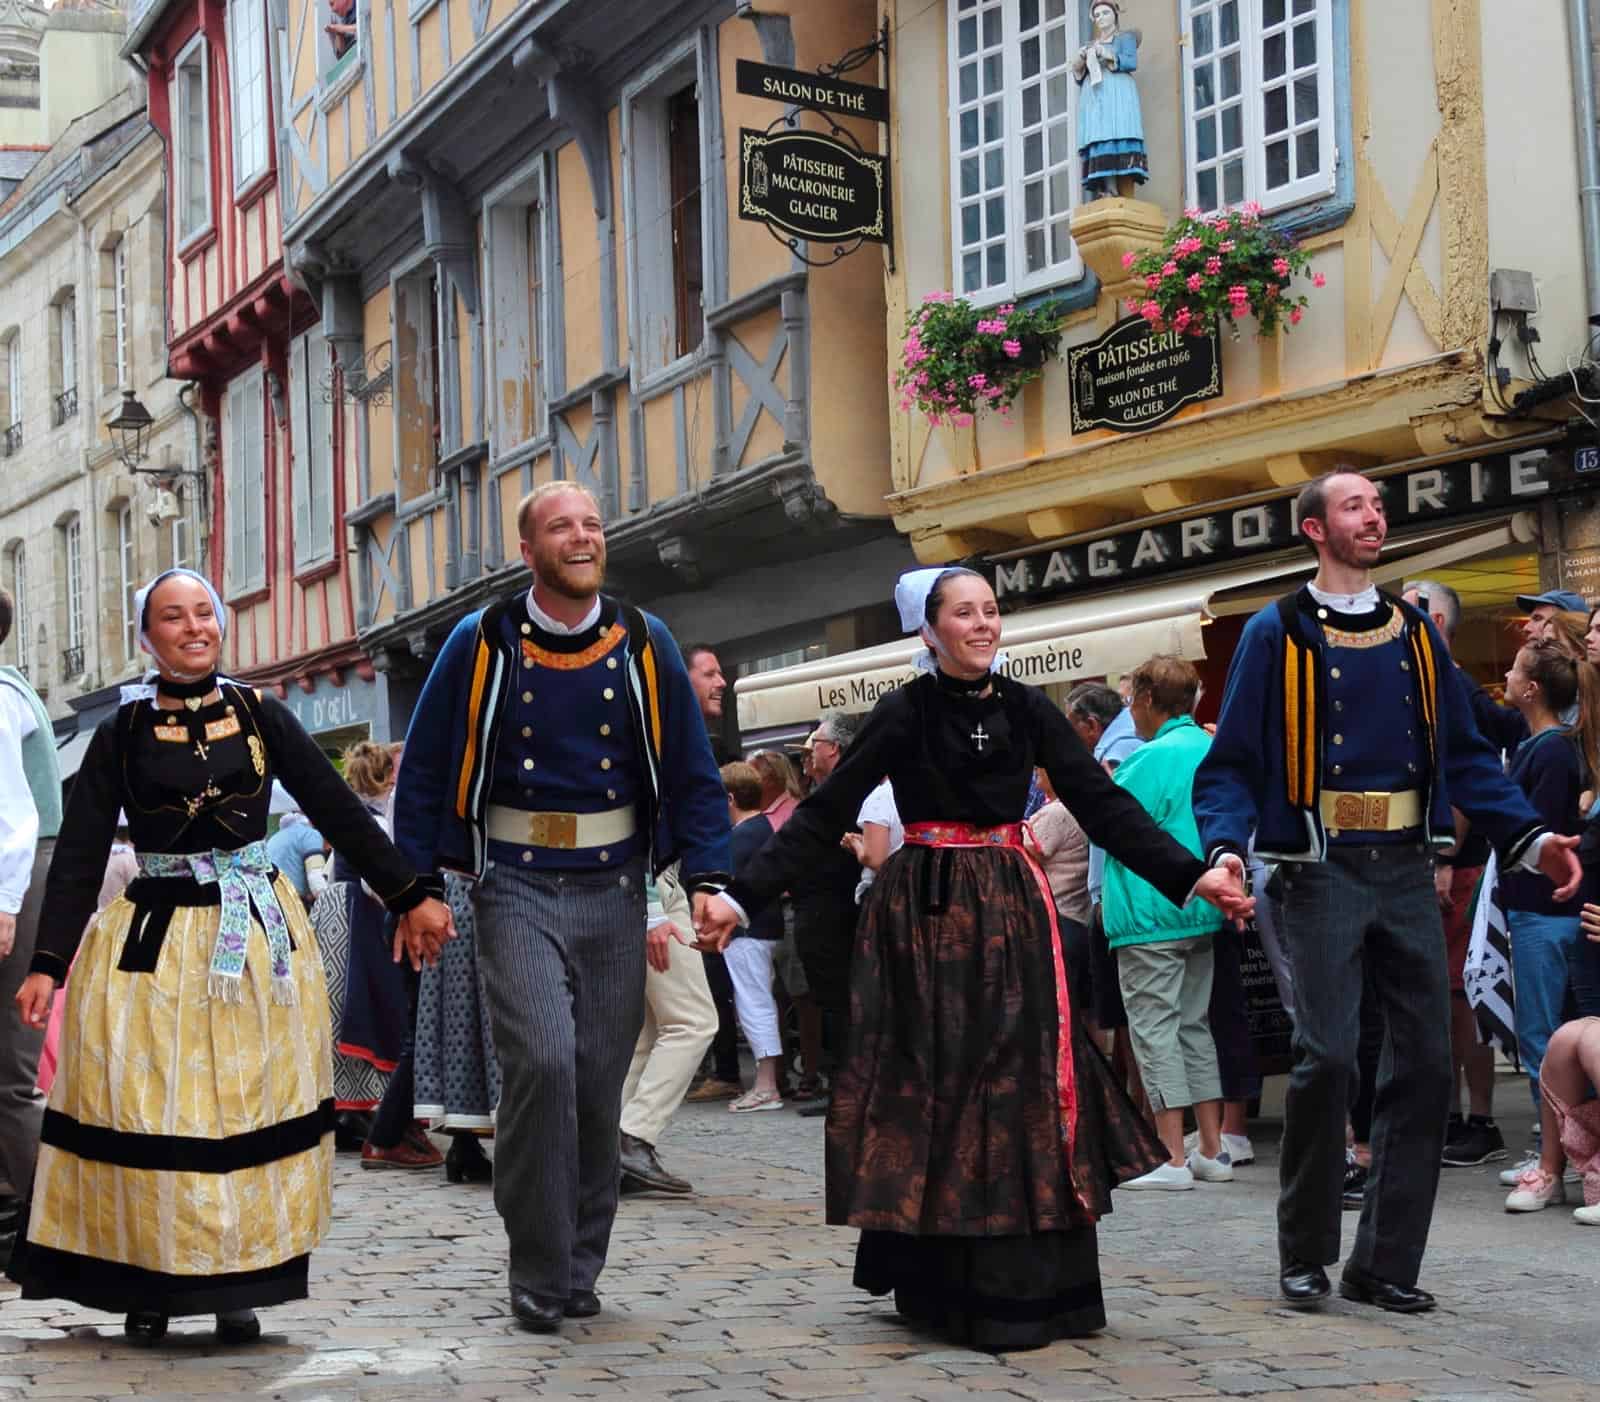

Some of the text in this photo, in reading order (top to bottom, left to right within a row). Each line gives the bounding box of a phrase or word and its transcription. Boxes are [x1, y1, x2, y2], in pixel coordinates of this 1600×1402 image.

[763, 77, 865, 111] SALON DE THÉ
[783, 153, 846, 181] PÂTISSERIE
[772, 173, 856, 203] MACARONERIE
[789, 200, 839, 222] GLACIER
[1098, 332, 1185, 370] PÂTISSERIE
[1096, 350, 1191, 387] maison fondée en 1966
[1108, 376, 1179, 409] SALON DE THÉ
[1123, 400, 1165, 421] GLACIER
[1581, 451, 1598, 469] 13
[995, 449, 1550, 598] MACARORIE
[818, 686, 847, 709] Les
[851, 671, 917, 704] Macar
